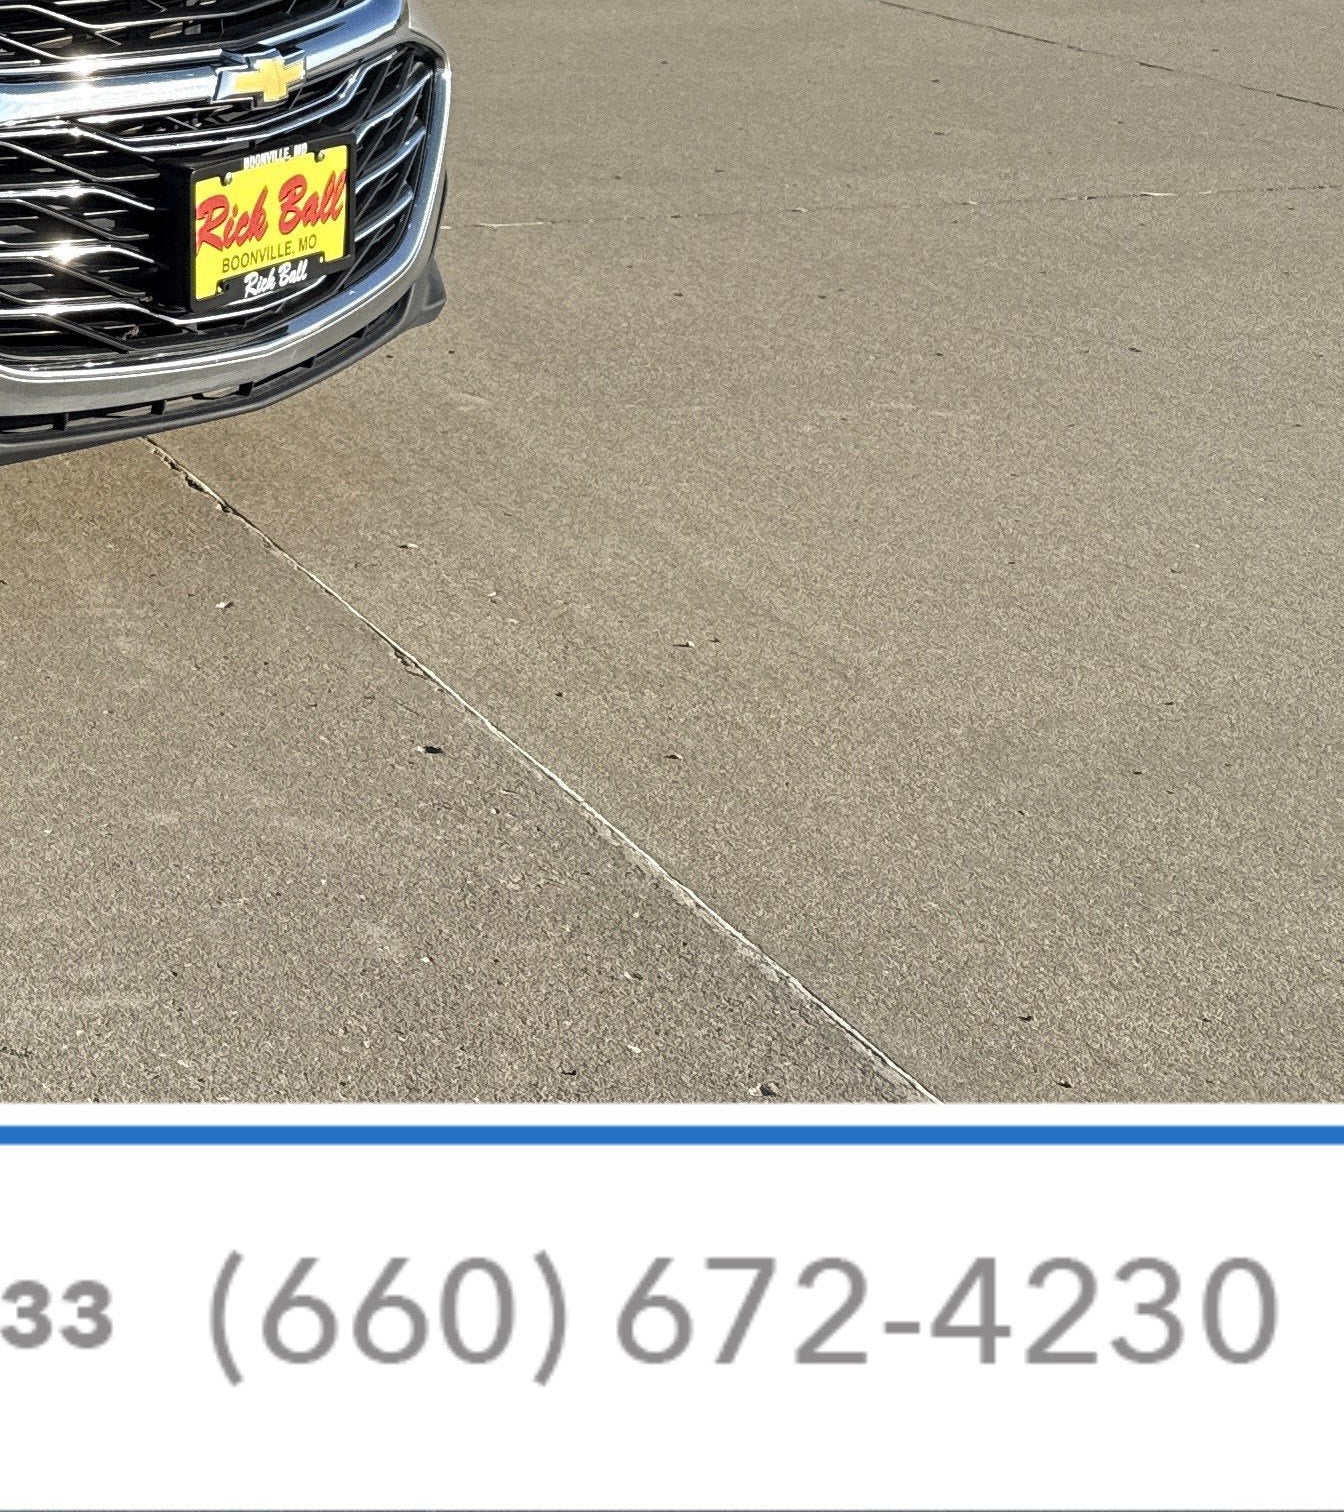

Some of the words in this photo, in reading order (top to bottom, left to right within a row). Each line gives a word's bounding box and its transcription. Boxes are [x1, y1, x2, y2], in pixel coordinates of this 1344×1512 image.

[294, 142, 308, 155] MO
[195, 185, 269, 257] Rick
[278, 169, 347, 235] Ball
[222, 240, 295, 274] BOONVILLE,
[298, 234, 318, 252] MO
[243, 267, 277, 299] Rick
[278, 259, 309, 287] Ball
